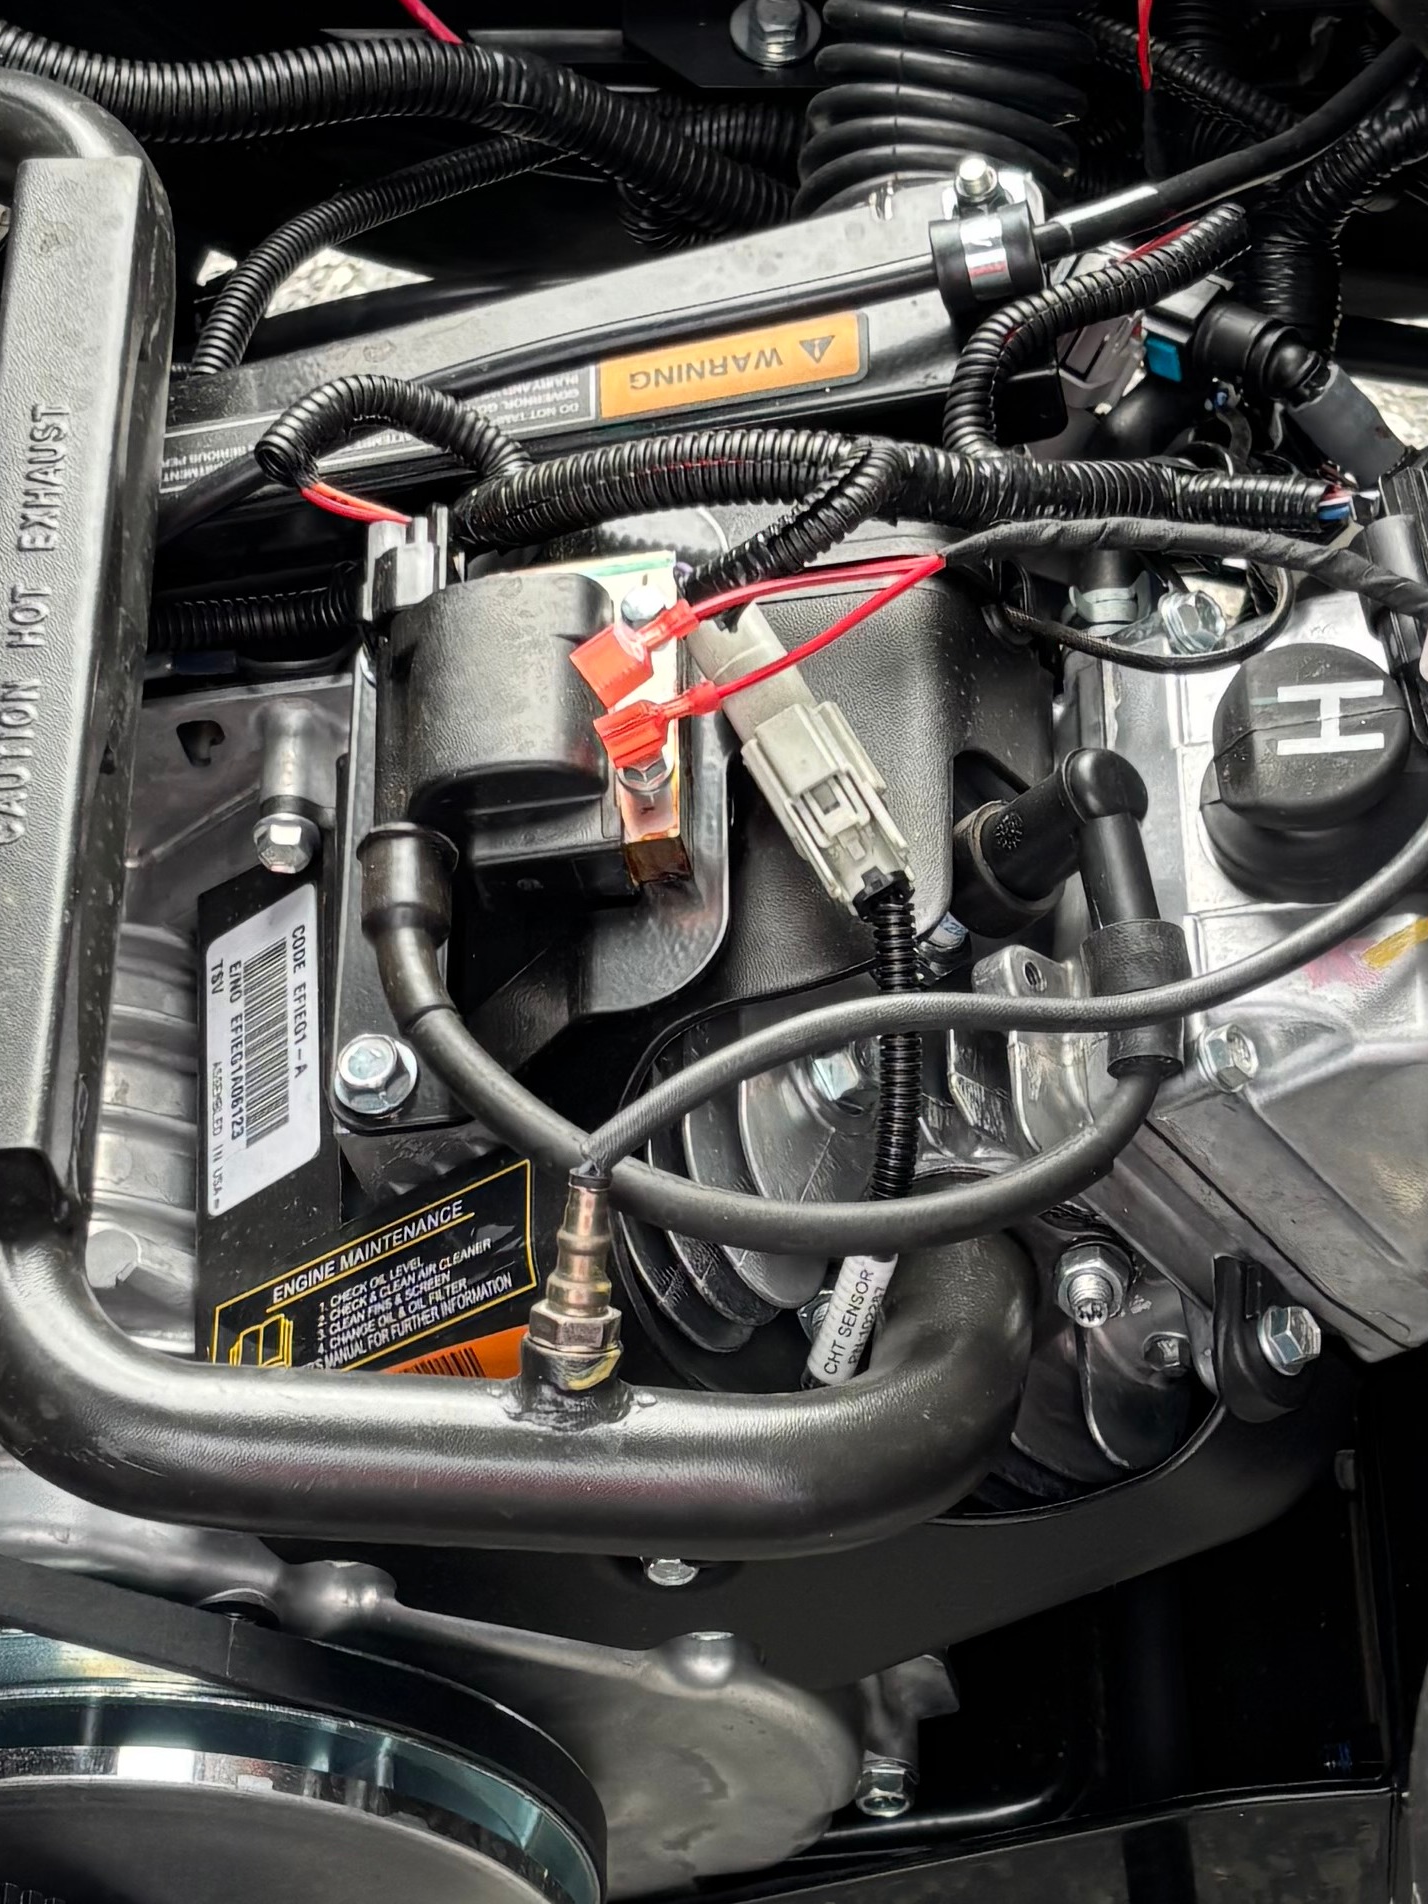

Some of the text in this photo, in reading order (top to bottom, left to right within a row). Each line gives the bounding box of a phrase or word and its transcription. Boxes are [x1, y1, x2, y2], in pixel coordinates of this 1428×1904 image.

[628, 346, 783, 391] WARNING
[528, 406, 557, 420] NOT
[558, 401, 580, 414] DO
[6, 398, 81, 558] EXHAUST
[0, 579, 56, 656] HOT
[209, 957, 224, 995] TSV
[290, 924, 306, 974] CODE
[227, 959, 242, 1004] E/NO
[211, 1145, 224, 1163] IN
[211, 1168, 224, 1196] USA
[272, 1198, 463, 1304] ENGINE MAINTENANCE
[330, 1294, 365, 1323] CHECK
[369, 1290, 375, 1304] &
[379, 1272, 414, 1300] CLEAN
[418, 1262, 434, 1282] AIR
[439, 1236, 491, 1272] CLEANER
[319, 1254, 421, 1313] 1. CHECK OIL LEVEL
[324, 1309, 363, 1339] CLEAN
[367, 1296, 390, 1319] FINS
[394, 1292, 400, 1306] &
[404, 1268, 449, 1301] SCREEN
[330, 1318, 374, 1351] CHANGE
[378, 1309, 393, 1328] OIL
[408, 1295, 423, 1314] OIL
[428, 1275, 465, 1305] FILTER
[327, 1338, 363, 1372] MANUAL
[369, 1326, 388, 1352] FOR
[394, 1304, 436, 1341] FURTHER
[442, 1270, 509, 1318] INFORMATION
[821, 1338, 847, 1376] CHT
[836, 1267, 875, 1339] SENSOR
